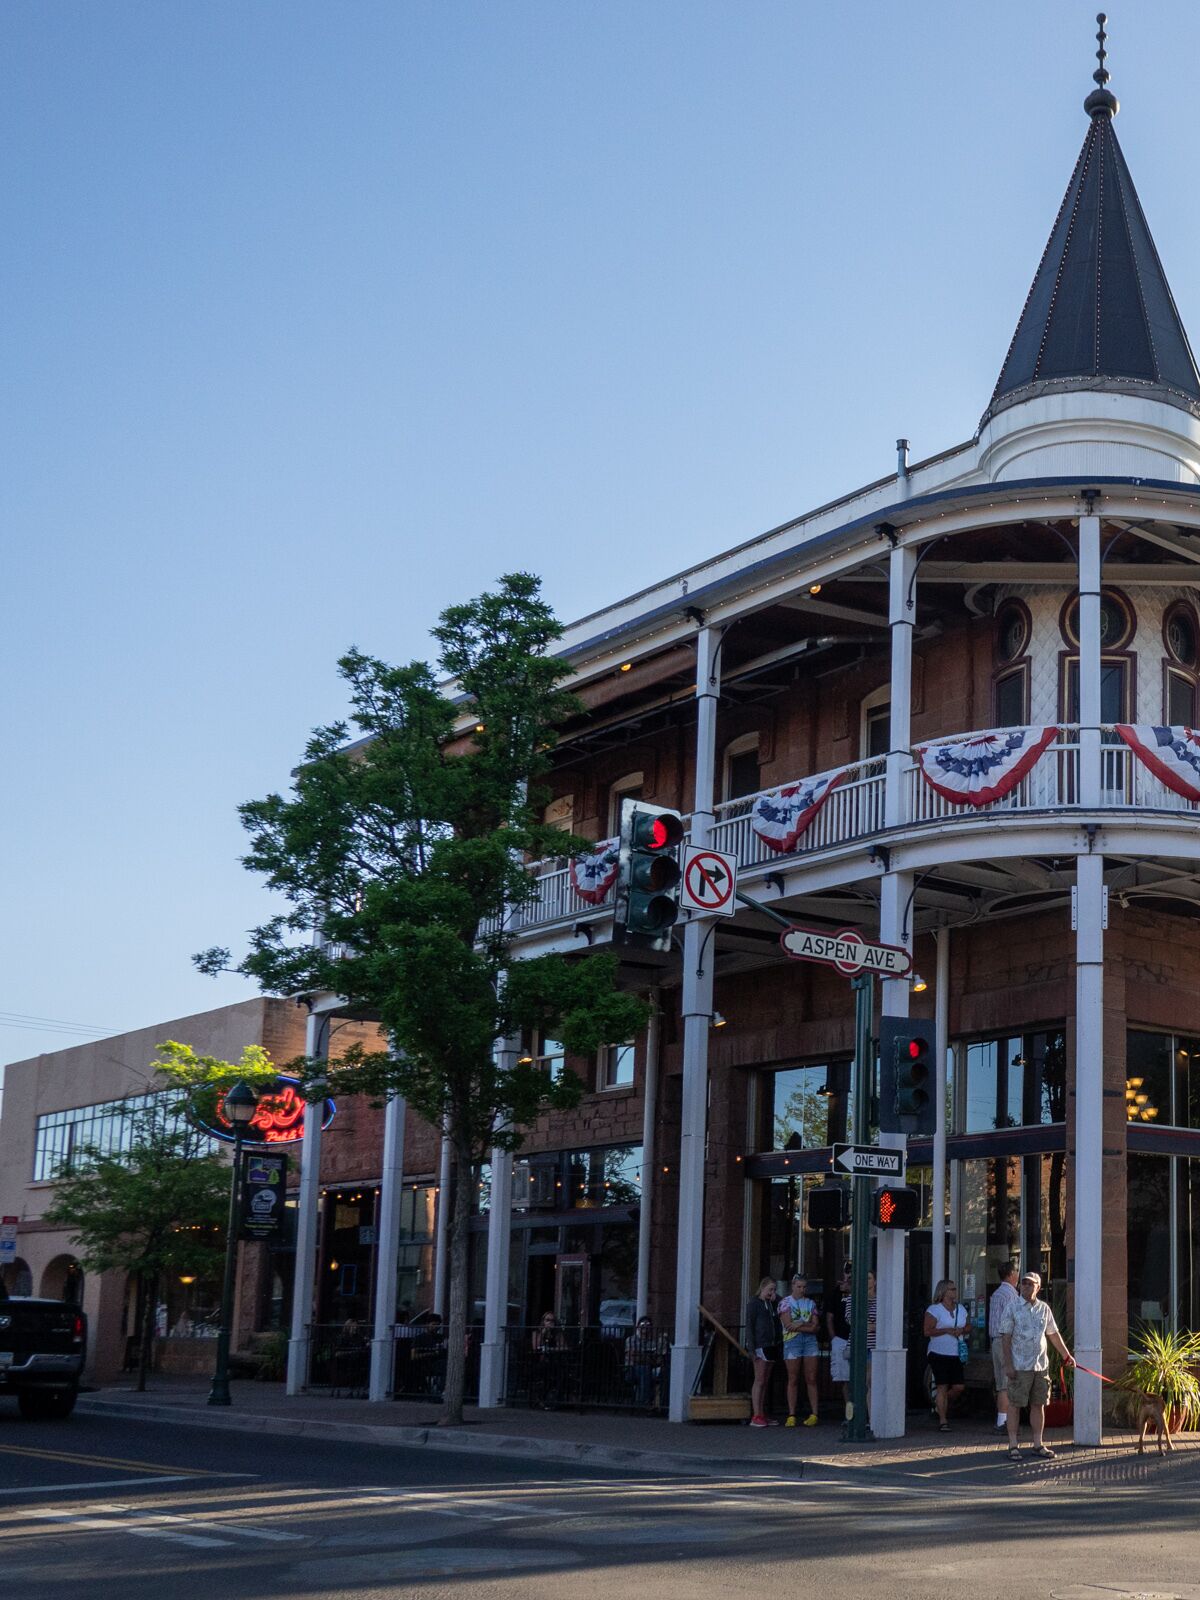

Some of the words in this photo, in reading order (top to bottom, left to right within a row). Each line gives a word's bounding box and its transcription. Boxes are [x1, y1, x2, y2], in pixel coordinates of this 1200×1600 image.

[801, 936, 857, 961] ASPEN
[863, 948, 895, 968] AVE
[855, 1154, 874, 1167] ONE
[876, 1156, 897, 1169] WAY
